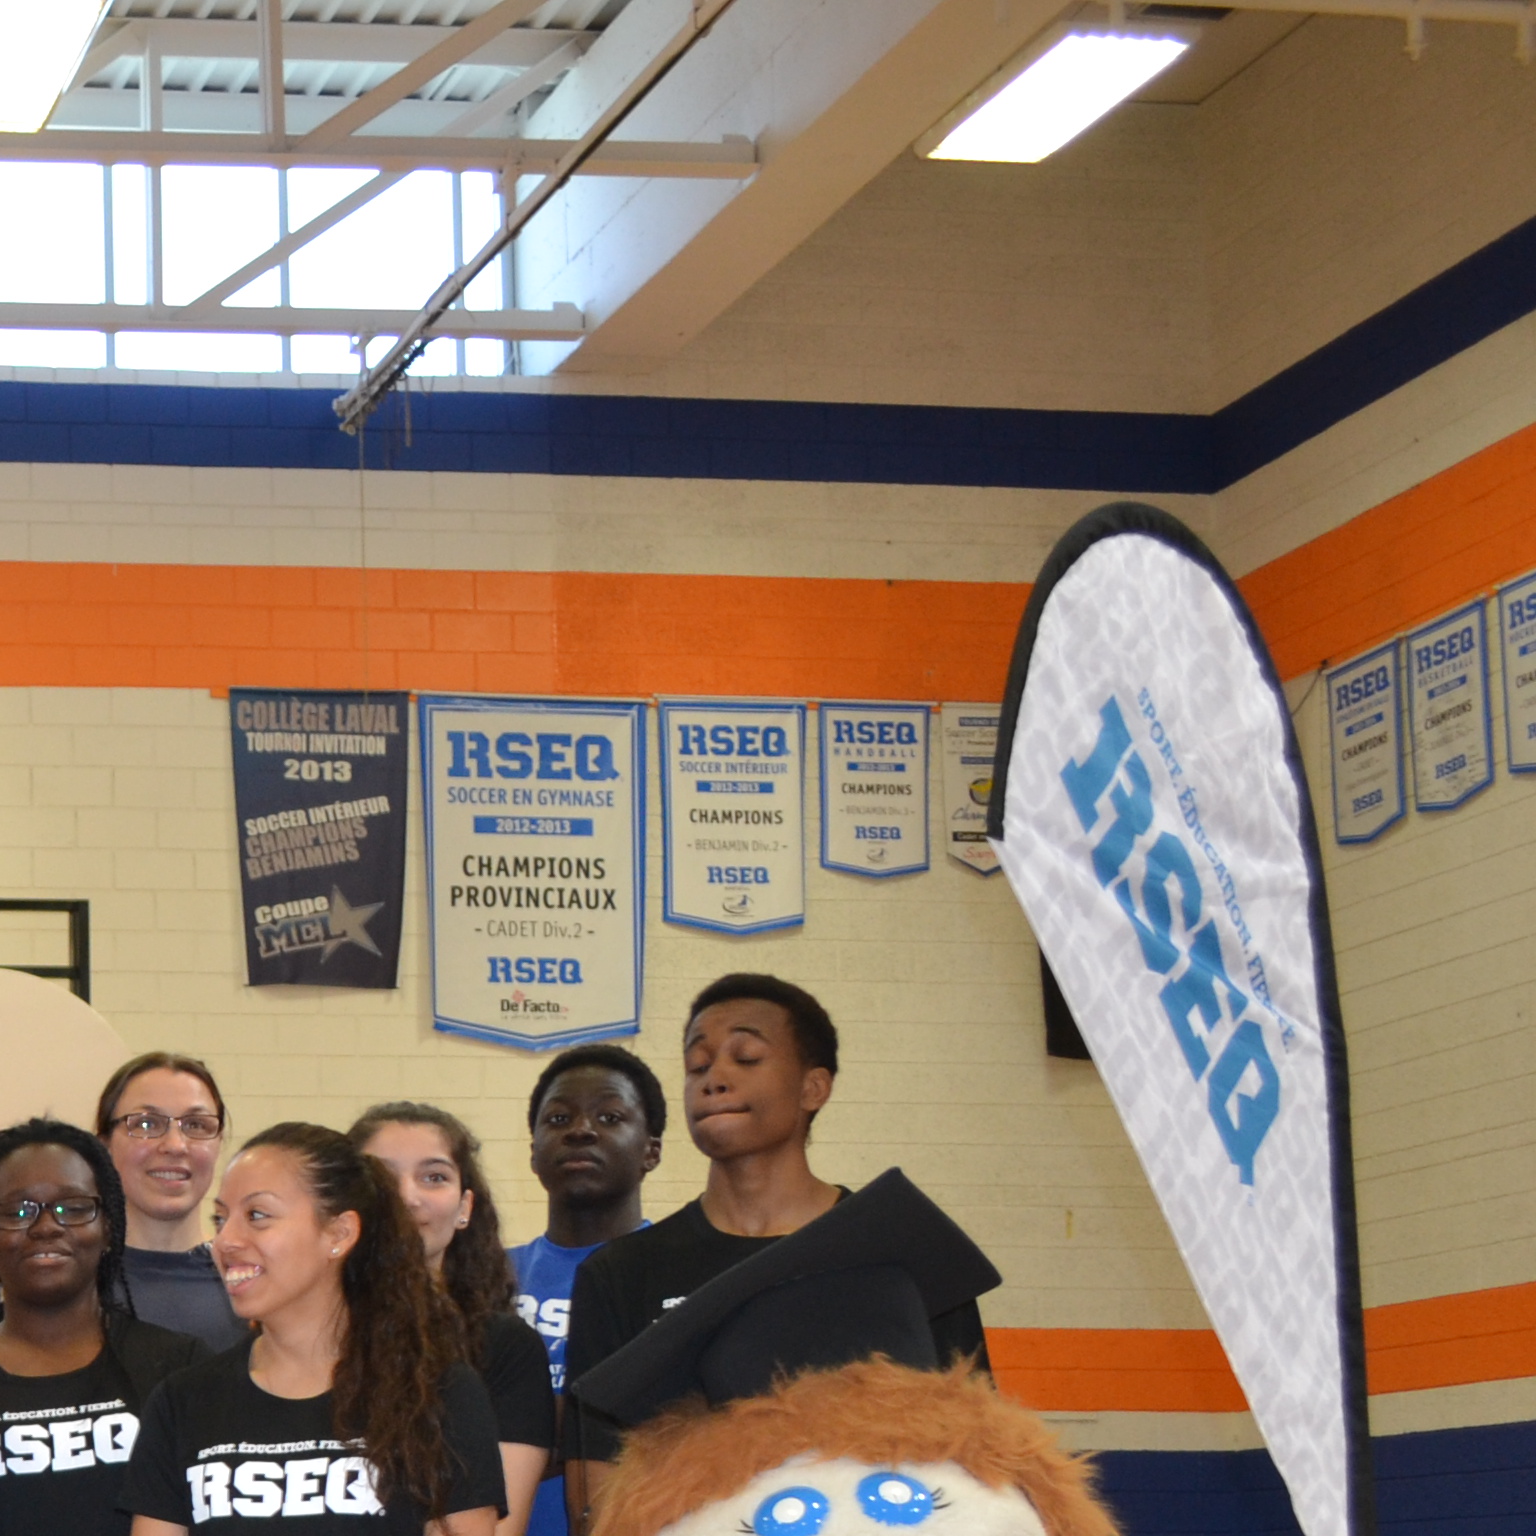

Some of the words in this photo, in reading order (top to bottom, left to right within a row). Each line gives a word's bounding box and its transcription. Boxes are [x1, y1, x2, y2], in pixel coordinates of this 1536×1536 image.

[1416, 625, 1475, 674] RSEQ
[1335, 665, 1391, 711] RSEQ
[237, 697, 330, 731] COLLÈGE
[335, 703, 400, 734] LAVAL
[1424, 699, 1473, 731] CHAMPIONS
[246, 732, 307, 753] TOURNOI
[309, 735, 386, 755] INVITATION
[678, 724, 791, 757] RSEQ
[833, 720, 918, 745] RSEQ
[447, 731, 620, 781] RSEQ
[834, 748, 916, 758] HANDBALL
[1342, 731, 1389, 762] CHAMPIONS
[283, 758, 353, 782] 2013
[679, 761, 722, 773] SOCCER
[725, 759, 788, 774] INTÉRIEUR
[1435, 753, 1467, 779] RSEQ
[447, 787, 508, 806] SOCCER
[513, 788, 533, 806] EN
[537, 788, 615, 808] GYMNASE
[841, 783, 912, 795] CHAMPIONS
[1352, 788, 1384, 814] RSEQ
[245, 809, 308, 837] SOCCER
[309, 796, 391, 826] INTÉRIEUR
[496, 818, 571, 835] 2012-2013
[689, 808, 783, 825] CHAMPIONS
[1137, 686, 1184, 788] SPORT.
[1179, 785, 1253, 955] ÉDUCATION.
[246, 817, 368, 858] CHAMPIONS
[695, 839, 749, 851] BENJAMIN
[752, 840, 779, 852] Div.2
[855, 826, 902, 840] RSEQ
[246, 840, 360, 880] BENJAMINS
[462, 854, 606, 880] CHAMPIONS
[707, 866, 770, 884] RSEQ
[254, 895, 328, 925] Coupe
[450, 885, 617, 911] PROVINCIAUX
[487, 920, 537, 938] CADET
[543, 920, 583, 939] Div.2
[1060, 696, 1280, 1186] RSEQ
[487, 956, 583, 985] RSEQ
[500, 998, 519, 1013] De
[522, 998, 561, 1014] Facto
[3, 1406, 78, 1421] ÉDUCATION.
[79, 1398, 125, 1413] FIERTÉ.
[238, 1440, 317, 1455] ÉDUCATION.
[186, 1456, 384, 1524] RSEQ
